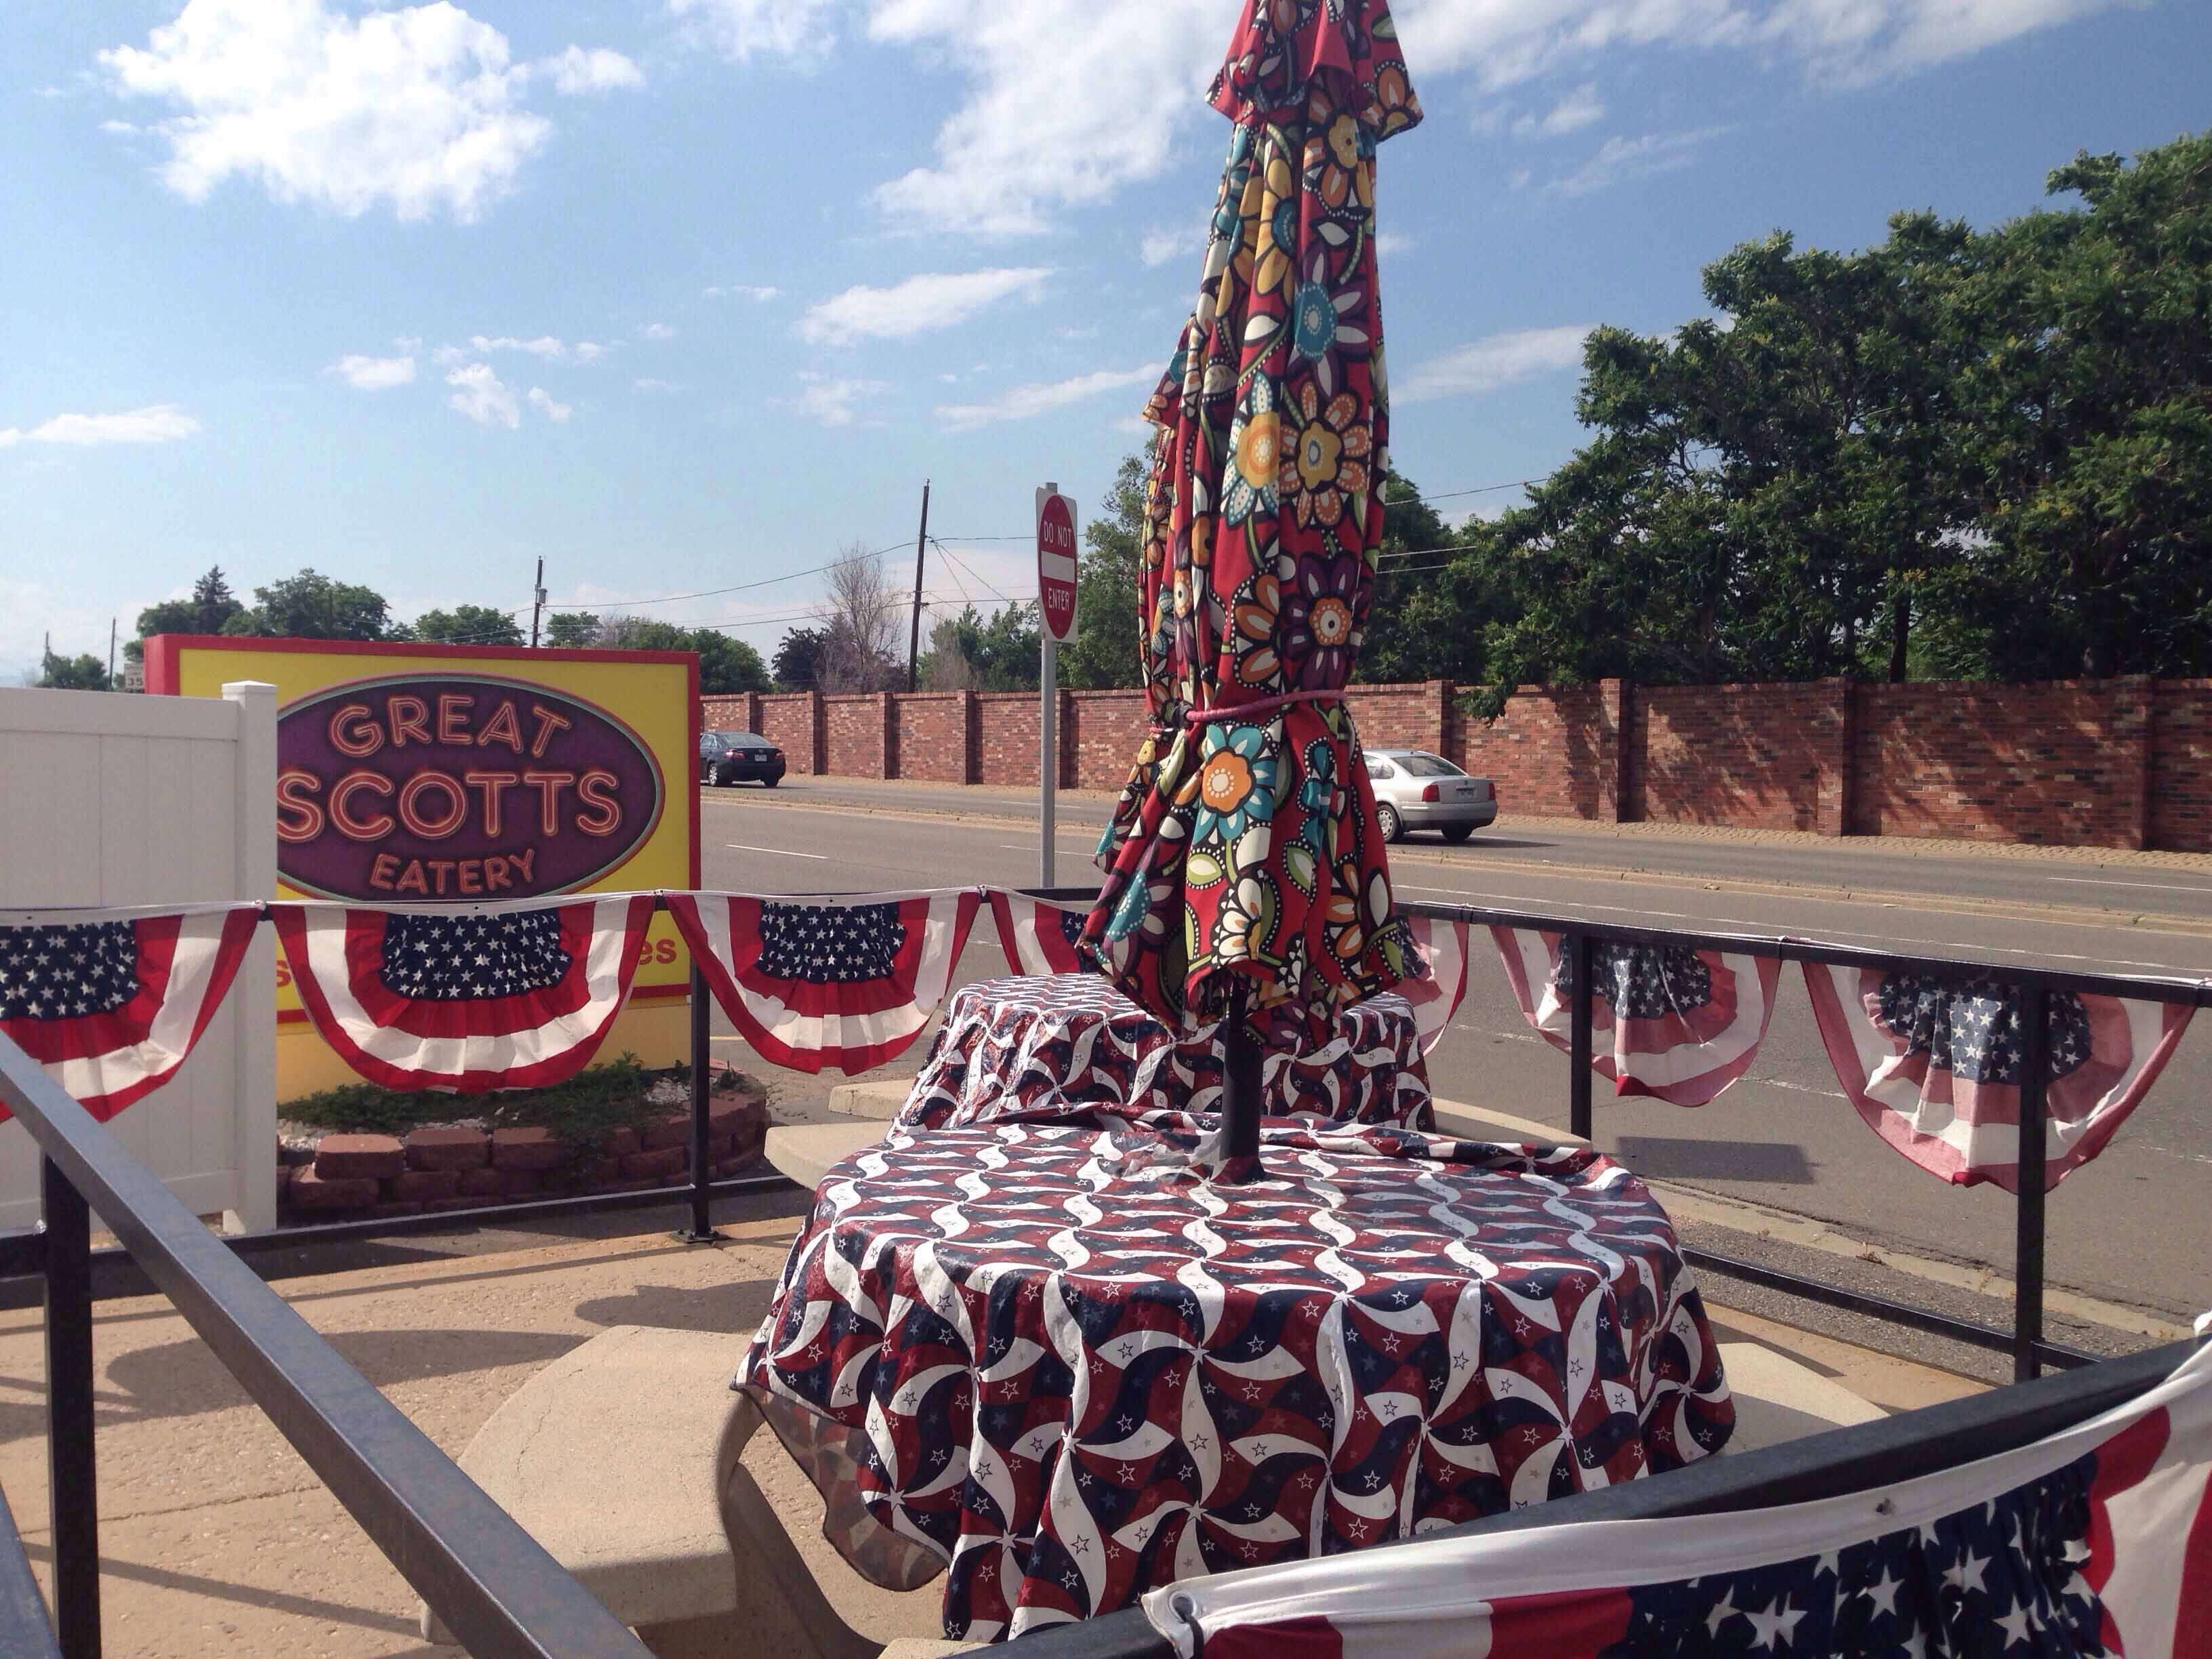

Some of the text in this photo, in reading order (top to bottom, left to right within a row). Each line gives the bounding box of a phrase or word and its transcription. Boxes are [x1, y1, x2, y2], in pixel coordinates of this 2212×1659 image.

[1044, 522, 1072, 548] DO NOT
[1048, 588, 1069, 611] ENTER
[329, 694, 572, 757] GREAT
[276, 769, 621, 842] SCOTTS
[369, 848, 535, 895] EATERY
